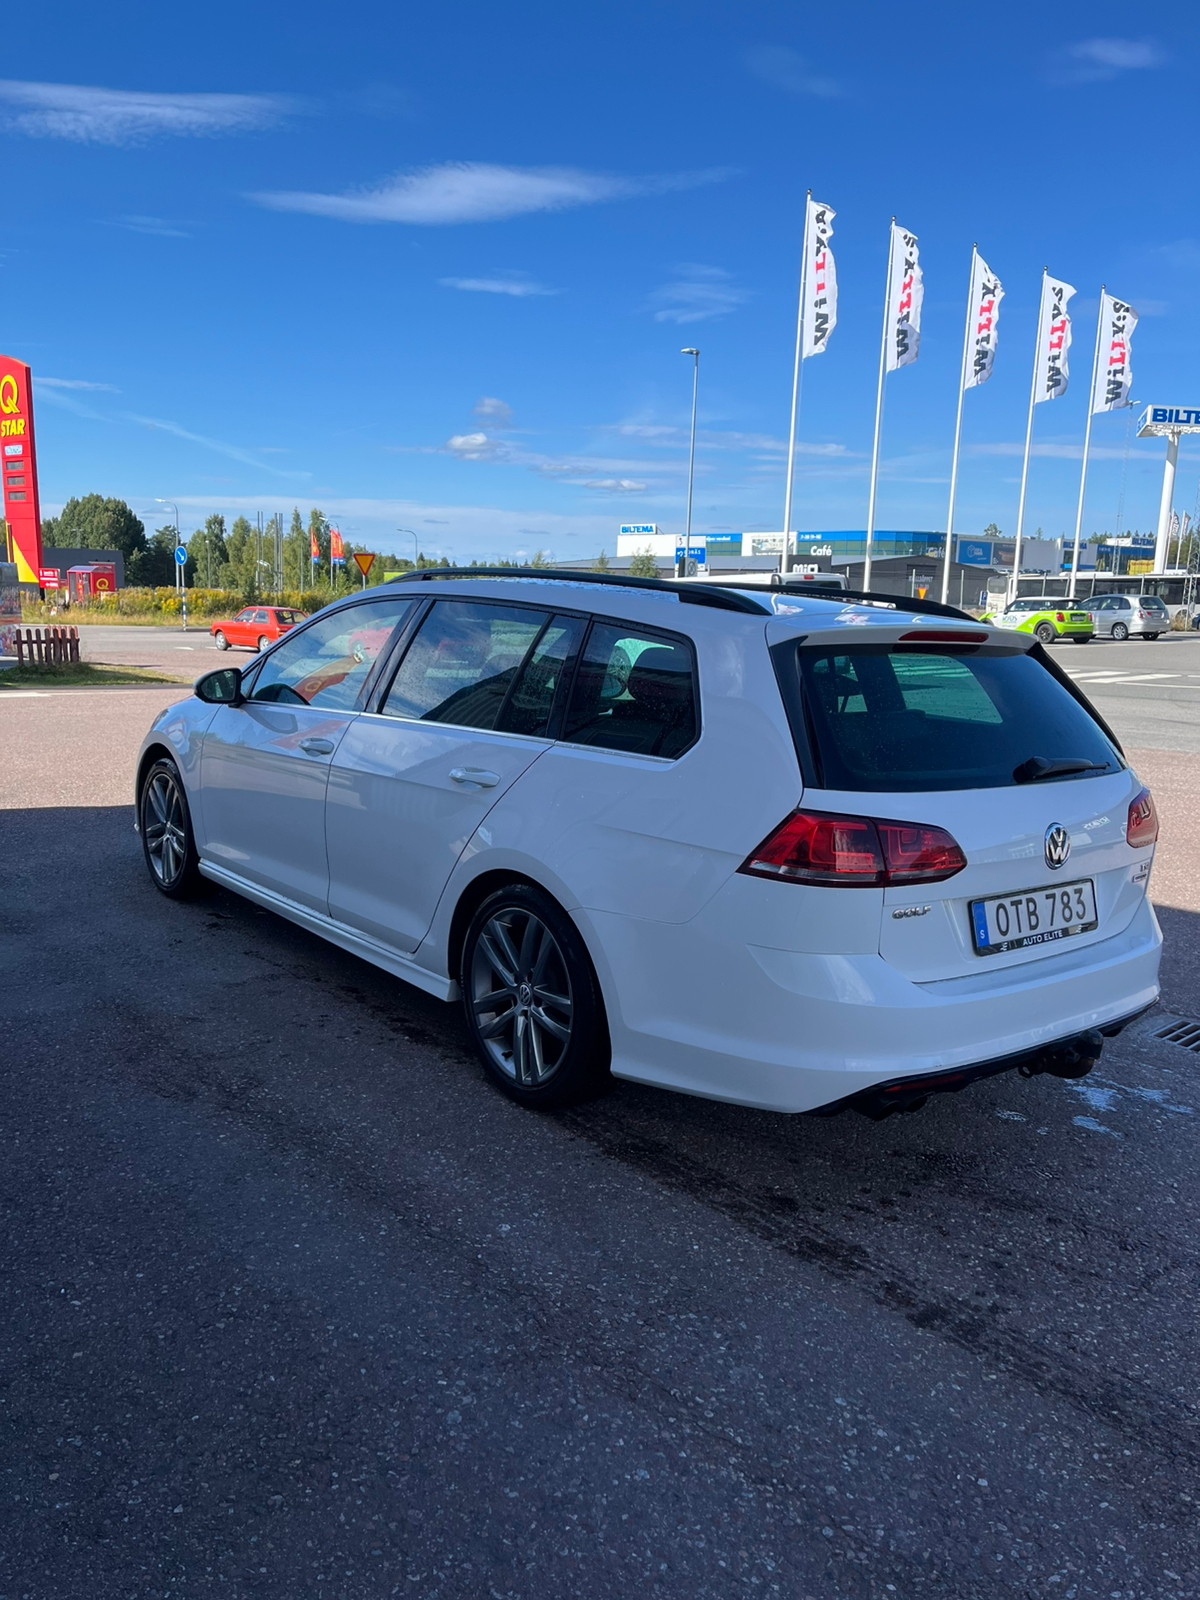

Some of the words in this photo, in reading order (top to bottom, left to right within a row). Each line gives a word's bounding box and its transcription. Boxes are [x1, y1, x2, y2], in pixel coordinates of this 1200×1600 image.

[0, 374, 21, 415] Q
[1, 418, 25, 437] STAR
[621, 525, 654, 533] BILTEMA
[810, 545, 832, 556] Café
[892, 905, 932, 919] GOLF
[996, 896, 1039, 937] OTB
[1045, 887, 1086, 927] 783
[979, 929, 985, 939] S
[1022, 935, 1043, 946] AUTO
[1044, 930, 1063, 942] ELITE
